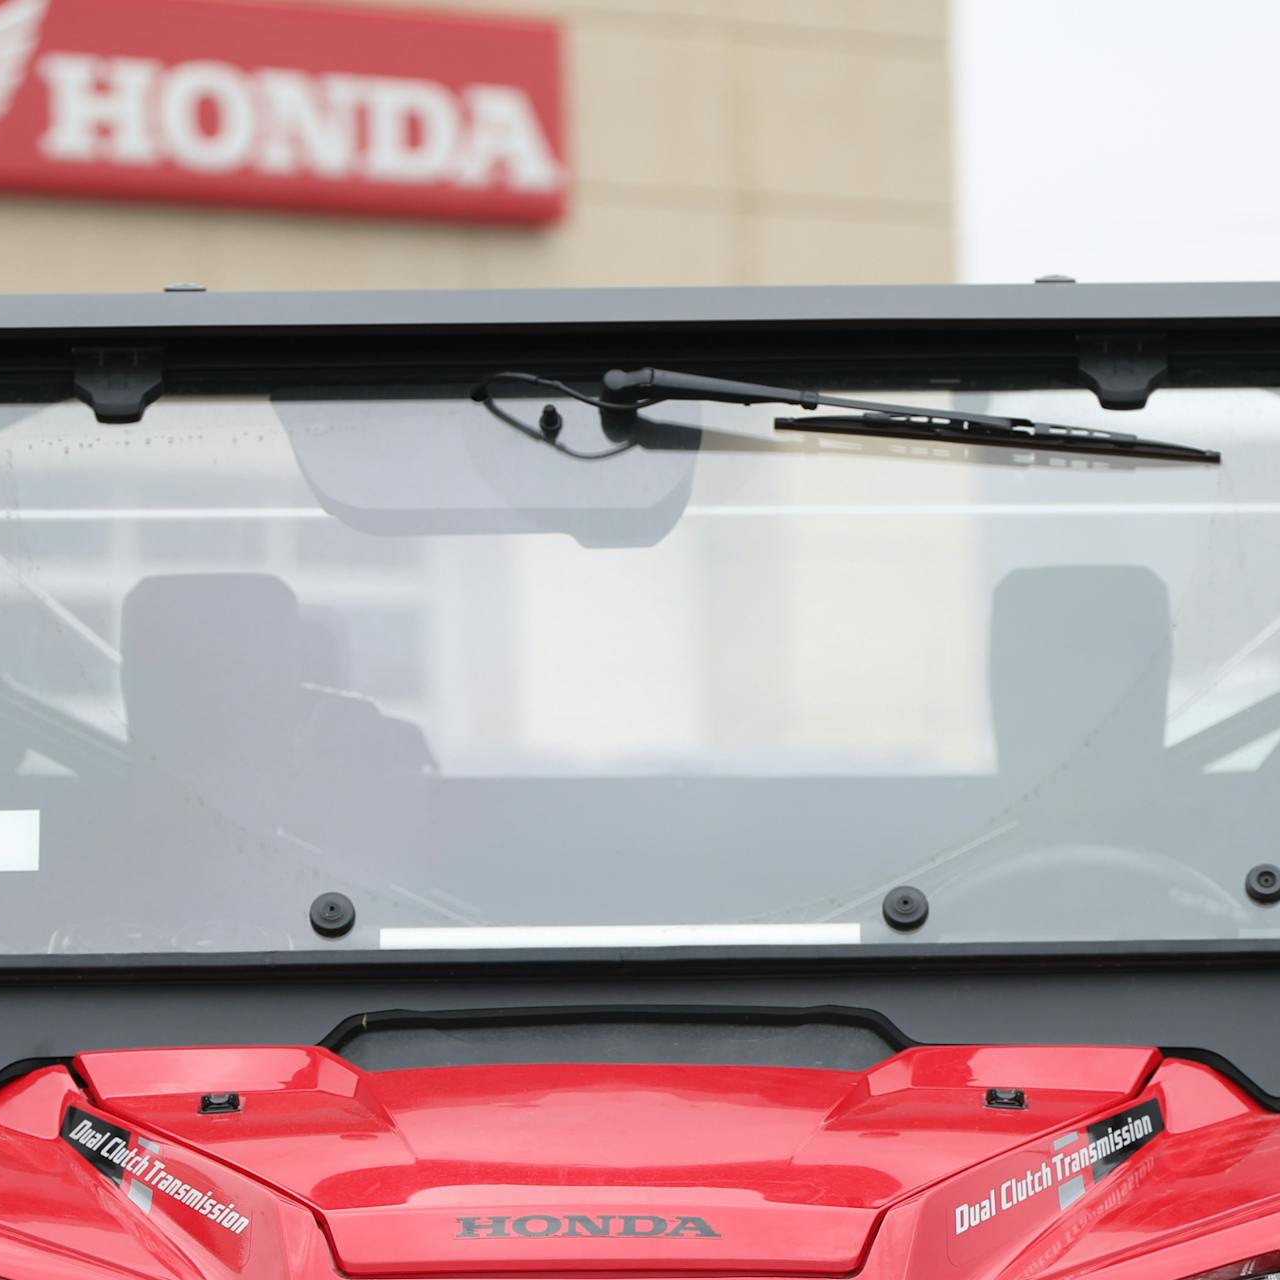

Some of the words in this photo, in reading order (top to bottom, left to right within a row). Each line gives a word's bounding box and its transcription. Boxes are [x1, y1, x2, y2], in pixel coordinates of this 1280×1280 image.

[39, 52, 560, 191] HONDA
[69, 1119, 111, 1151] Dual
[100, 1136, 151, 1179] Clutch
[144, 1160, 250, 1234] Transmission
[456, 1215, 722, 1238] HONDA
[955, 1190, 996, 1235] Dual
[1001, 1162, 1052, 1210] Clutch
[1052, 1114, 1153, 1181] Transmission
